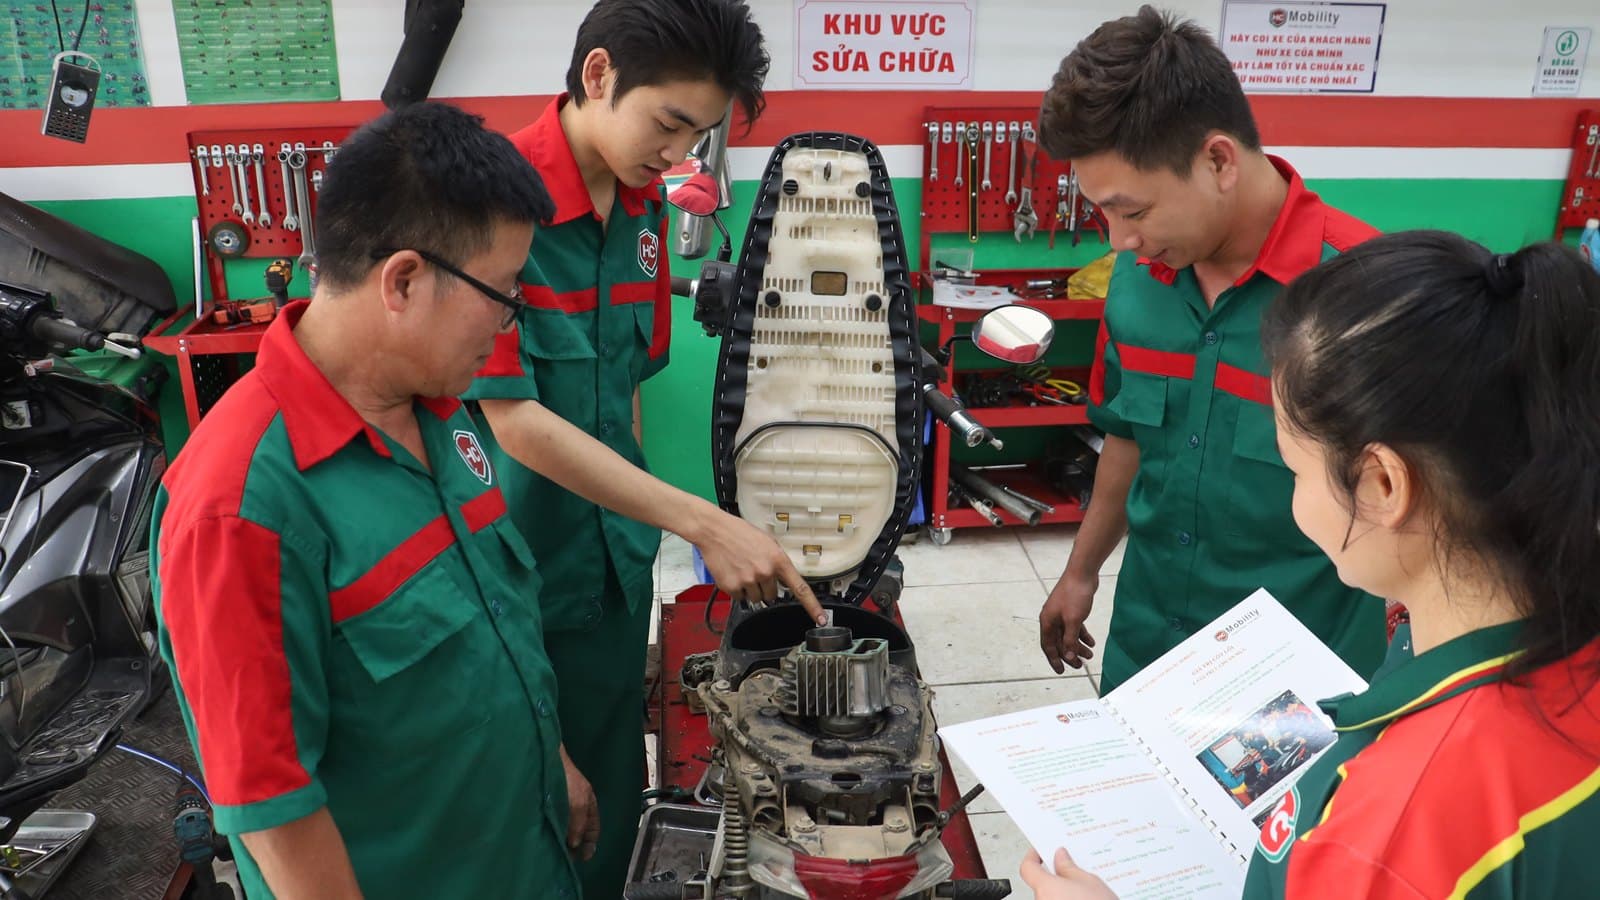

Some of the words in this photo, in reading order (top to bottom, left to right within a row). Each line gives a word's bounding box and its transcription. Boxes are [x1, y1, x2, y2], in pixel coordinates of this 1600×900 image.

[1289, 10, 1340, 25] Mobility
[824, 14, 881, 35] KHU
[891, 13, 946, 40] VỰC
[1252, 34, 1269, 43] COI
[1272, 35, 1283, 44] XE
[1287, 32, 1306, 44] CỦA
[1309, 34, 1342, 44] KHÁCH
[812, 44, 870, 72] SỬA
[879, 48, 955, 72] CHỮA
[1256, 48, 1278, 57] NHƯ
[1280, 49, 1291, 57] XE
[1294, 47, 1314, 57] CỦA
[1276, 61, 1293, 71] TỐT
[1345, 62, 1366, 72] XÁC
[642, 244, 656, 258] HC
[1225, 608, 1259, 633] Mobility
